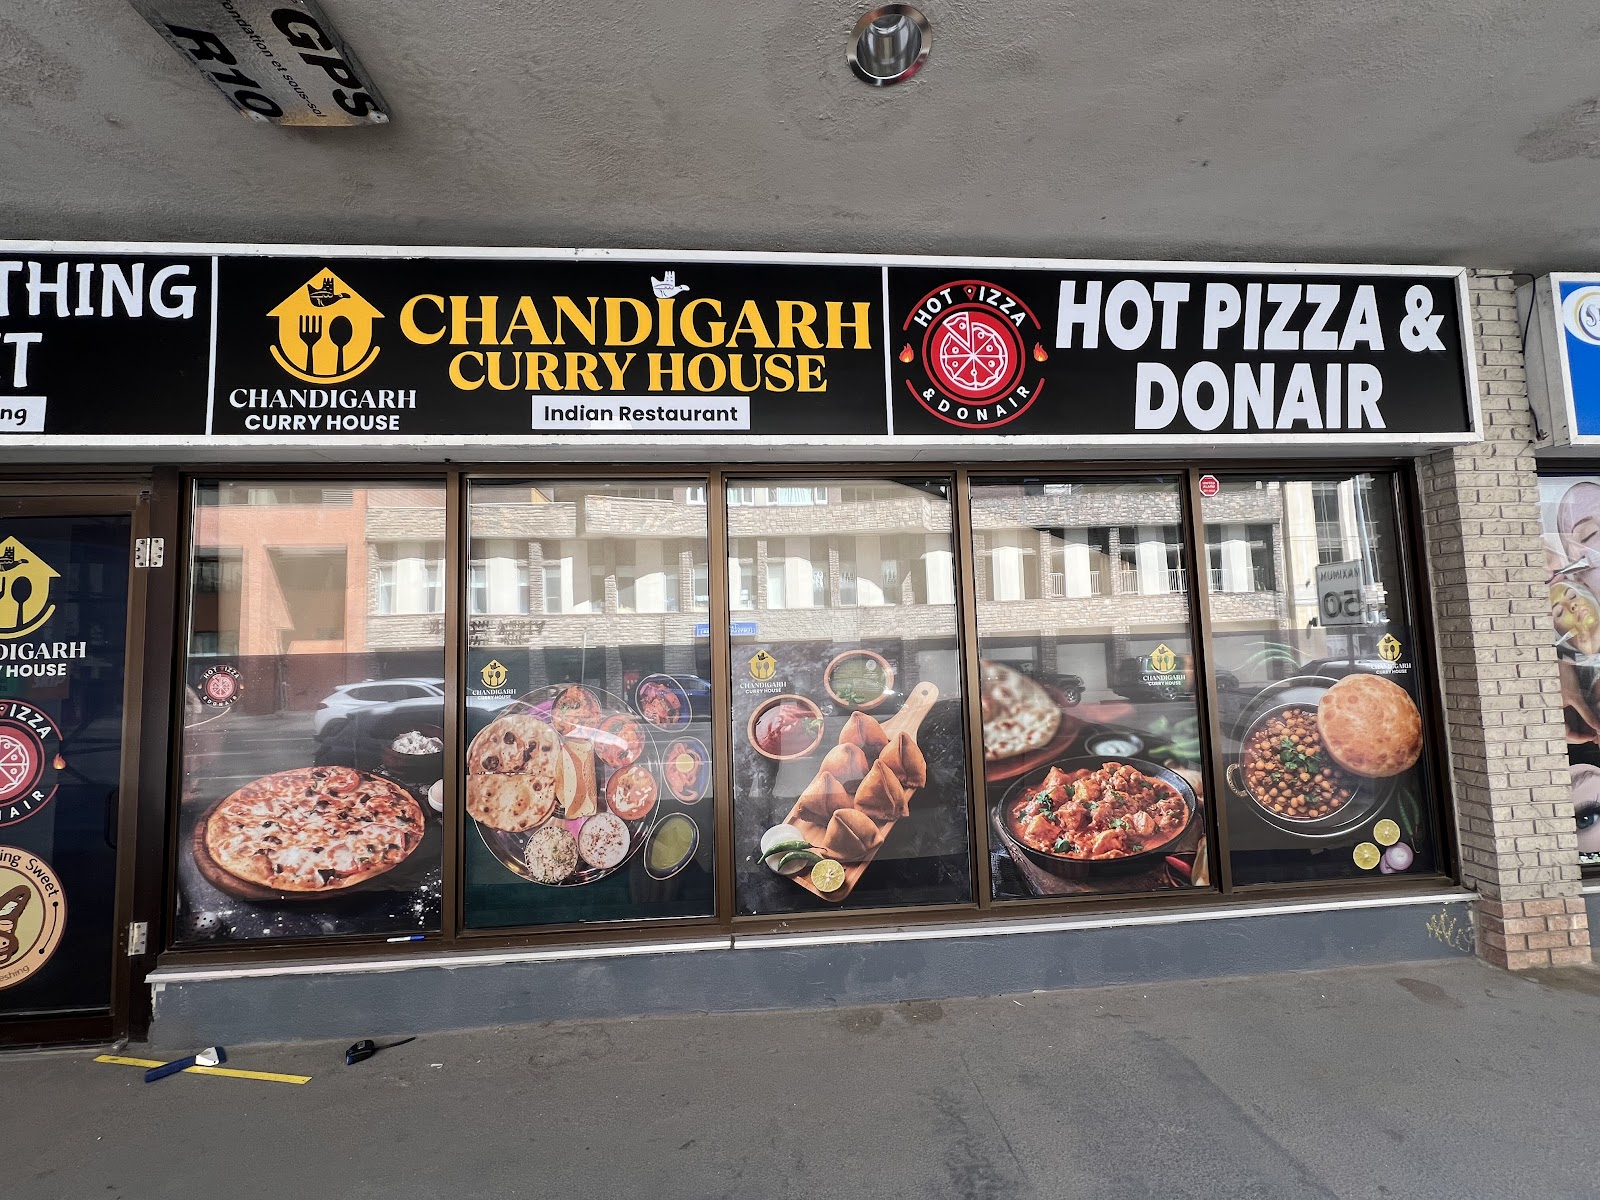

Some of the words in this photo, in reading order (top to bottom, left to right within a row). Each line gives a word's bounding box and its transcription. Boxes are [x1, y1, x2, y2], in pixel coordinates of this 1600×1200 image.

[164, 24, 284, 118] R10
[221, 0, 274, 58] ondation
[271, 60, 288, 72] et
[283, 74, 327, 117] sous-sol
[271, 8, 378, 118] GPS
[400, 293, 872, 350] CHANDIGARH
[913, 288, 953, 327] HOT
[1055, 279, 1190, 351] HOT
[1203, 282, 1386, 352] PIZZA
[1399, 284, 1447, 352] &
[0, 332, 43, 388] T
[448, 351, 639, 391] CURRY
[648, 353, 828, 392] HOUSE
[229, 388, 417, 409] CHANDIGARH
[543, 405, 614, 422] Indian
[619, 405, 738, 423] Restaurant
[922, 388, 936, 401] &
[937, 385, 1031, 422] DONAIR
[1134, 360, 1387, 431] DONAIR
[245, 415, 322, 431] CURRY
[326, 415, 400, 431] HOUSE
[6, 663, 67, 678] HOUSE
[203, 667, 217, 679] HOT
[740, 681, 787, 689] CHANDIGARH
[472, 688, 516, 696] CHANDIGARH
[0, 789, 45, 820] AIR
[25, 858, 60, 898] Sweet
